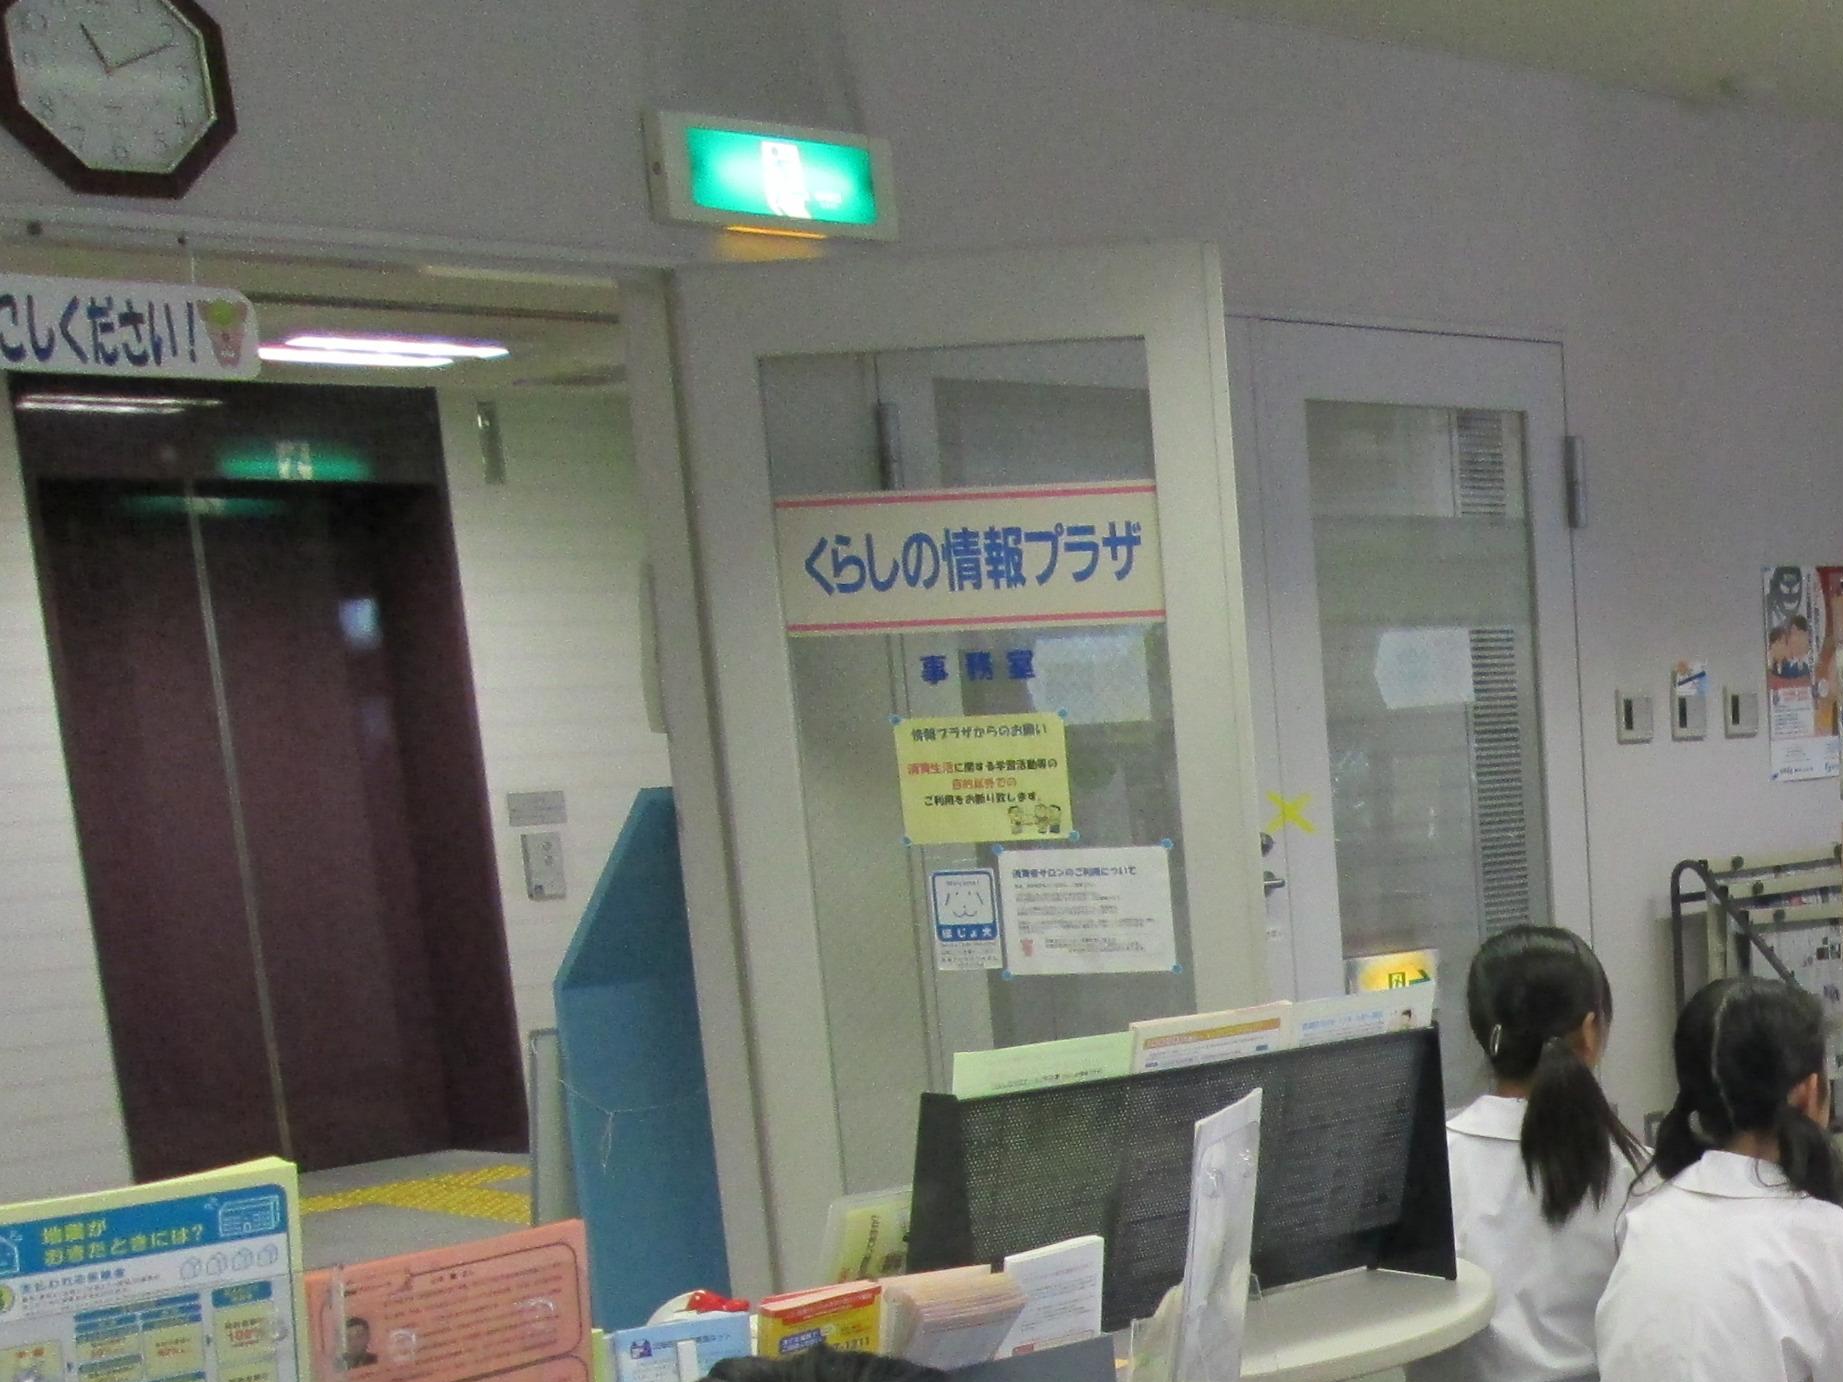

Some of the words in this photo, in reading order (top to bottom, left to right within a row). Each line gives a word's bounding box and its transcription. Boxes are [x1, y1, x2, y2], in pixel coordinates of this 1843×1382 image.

[805, 521, 1142, 596] くらしの情報プラザ
[920, 650, 1036, 685] 事務室
[911, 723, 1047, 742] 情報プラザからのお願い
